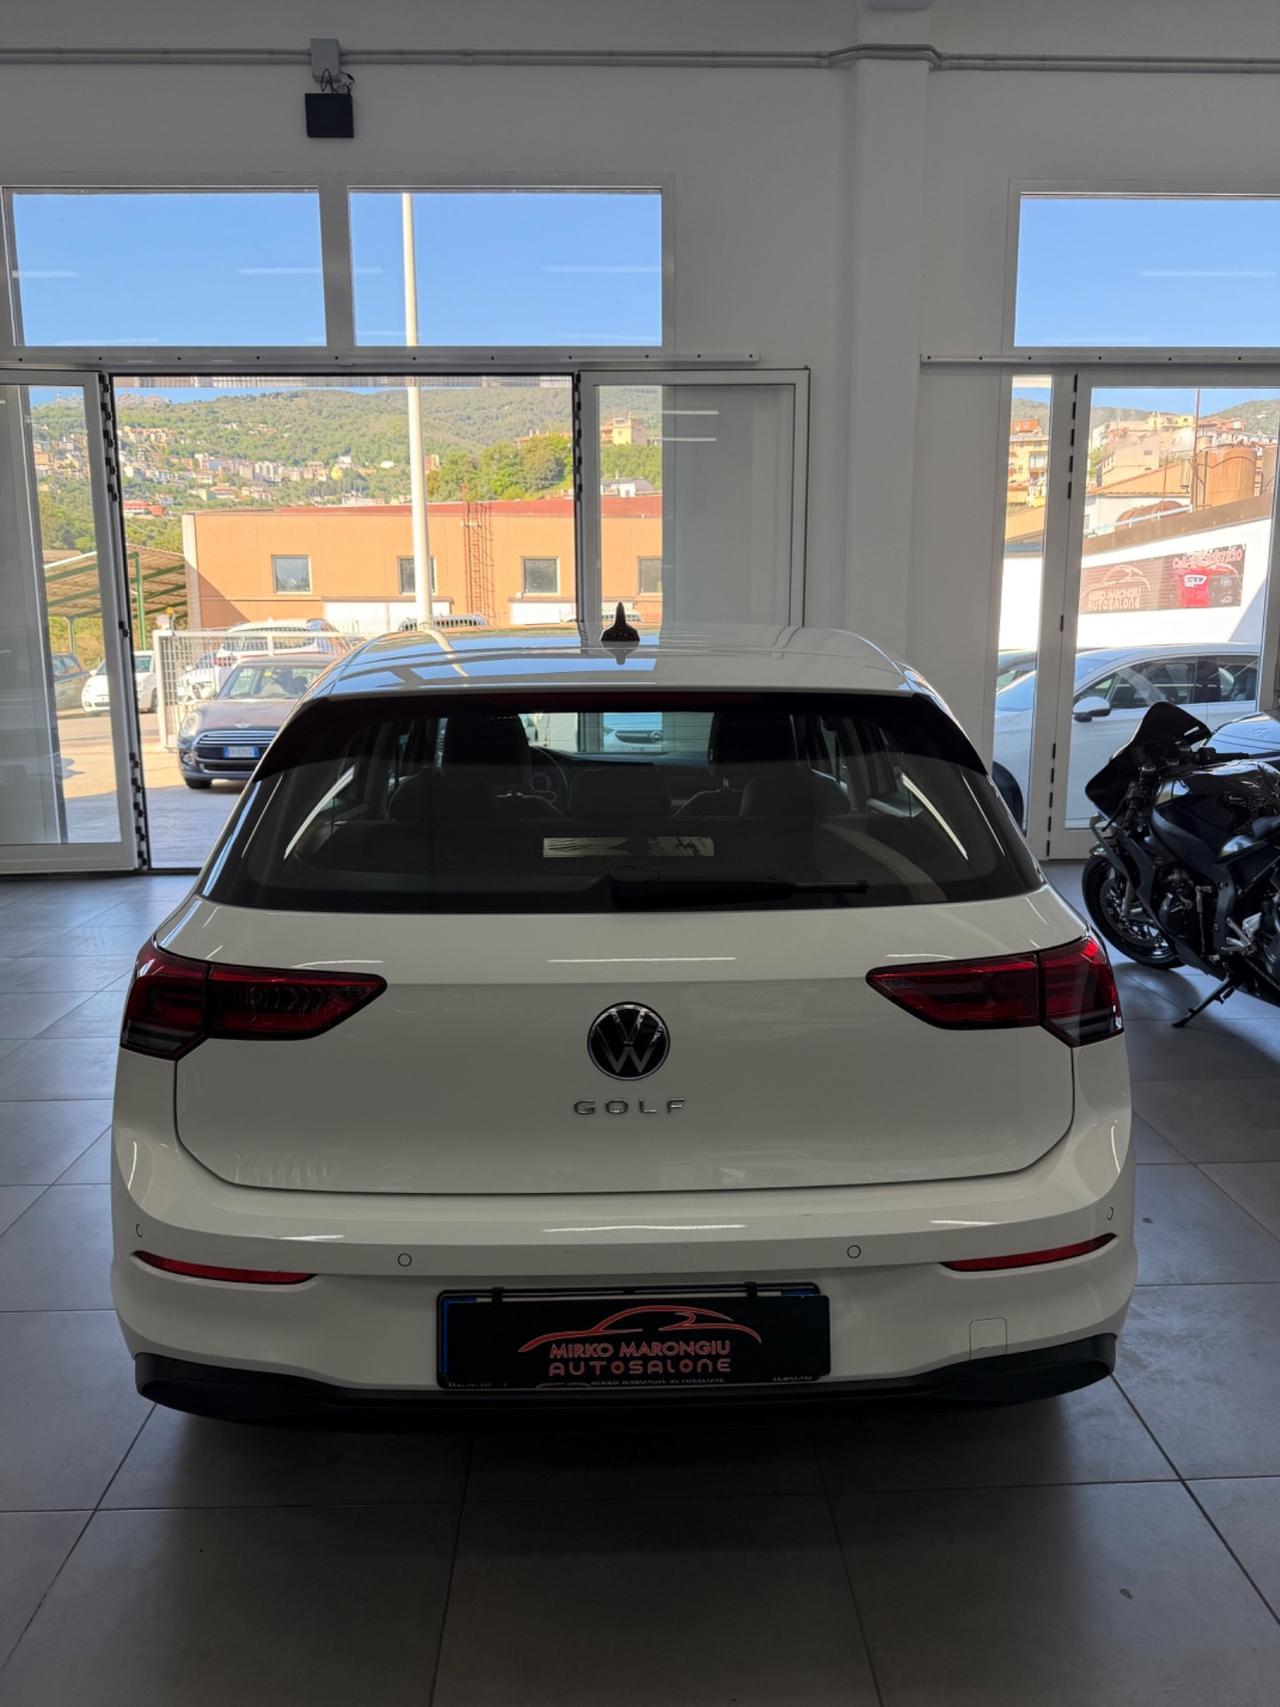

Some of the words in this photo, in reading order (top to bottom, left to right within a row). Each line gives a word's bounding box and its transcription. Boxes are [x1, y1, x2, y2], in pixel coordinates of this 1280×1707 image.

[574, 1099, 685, 1115] GOLF
[549, 1342, 614, 1358] MIRKO
[619, 1340, 731, 1357] MARONGIU
[548, 1358, 731, 1376] AUTOSALONE
